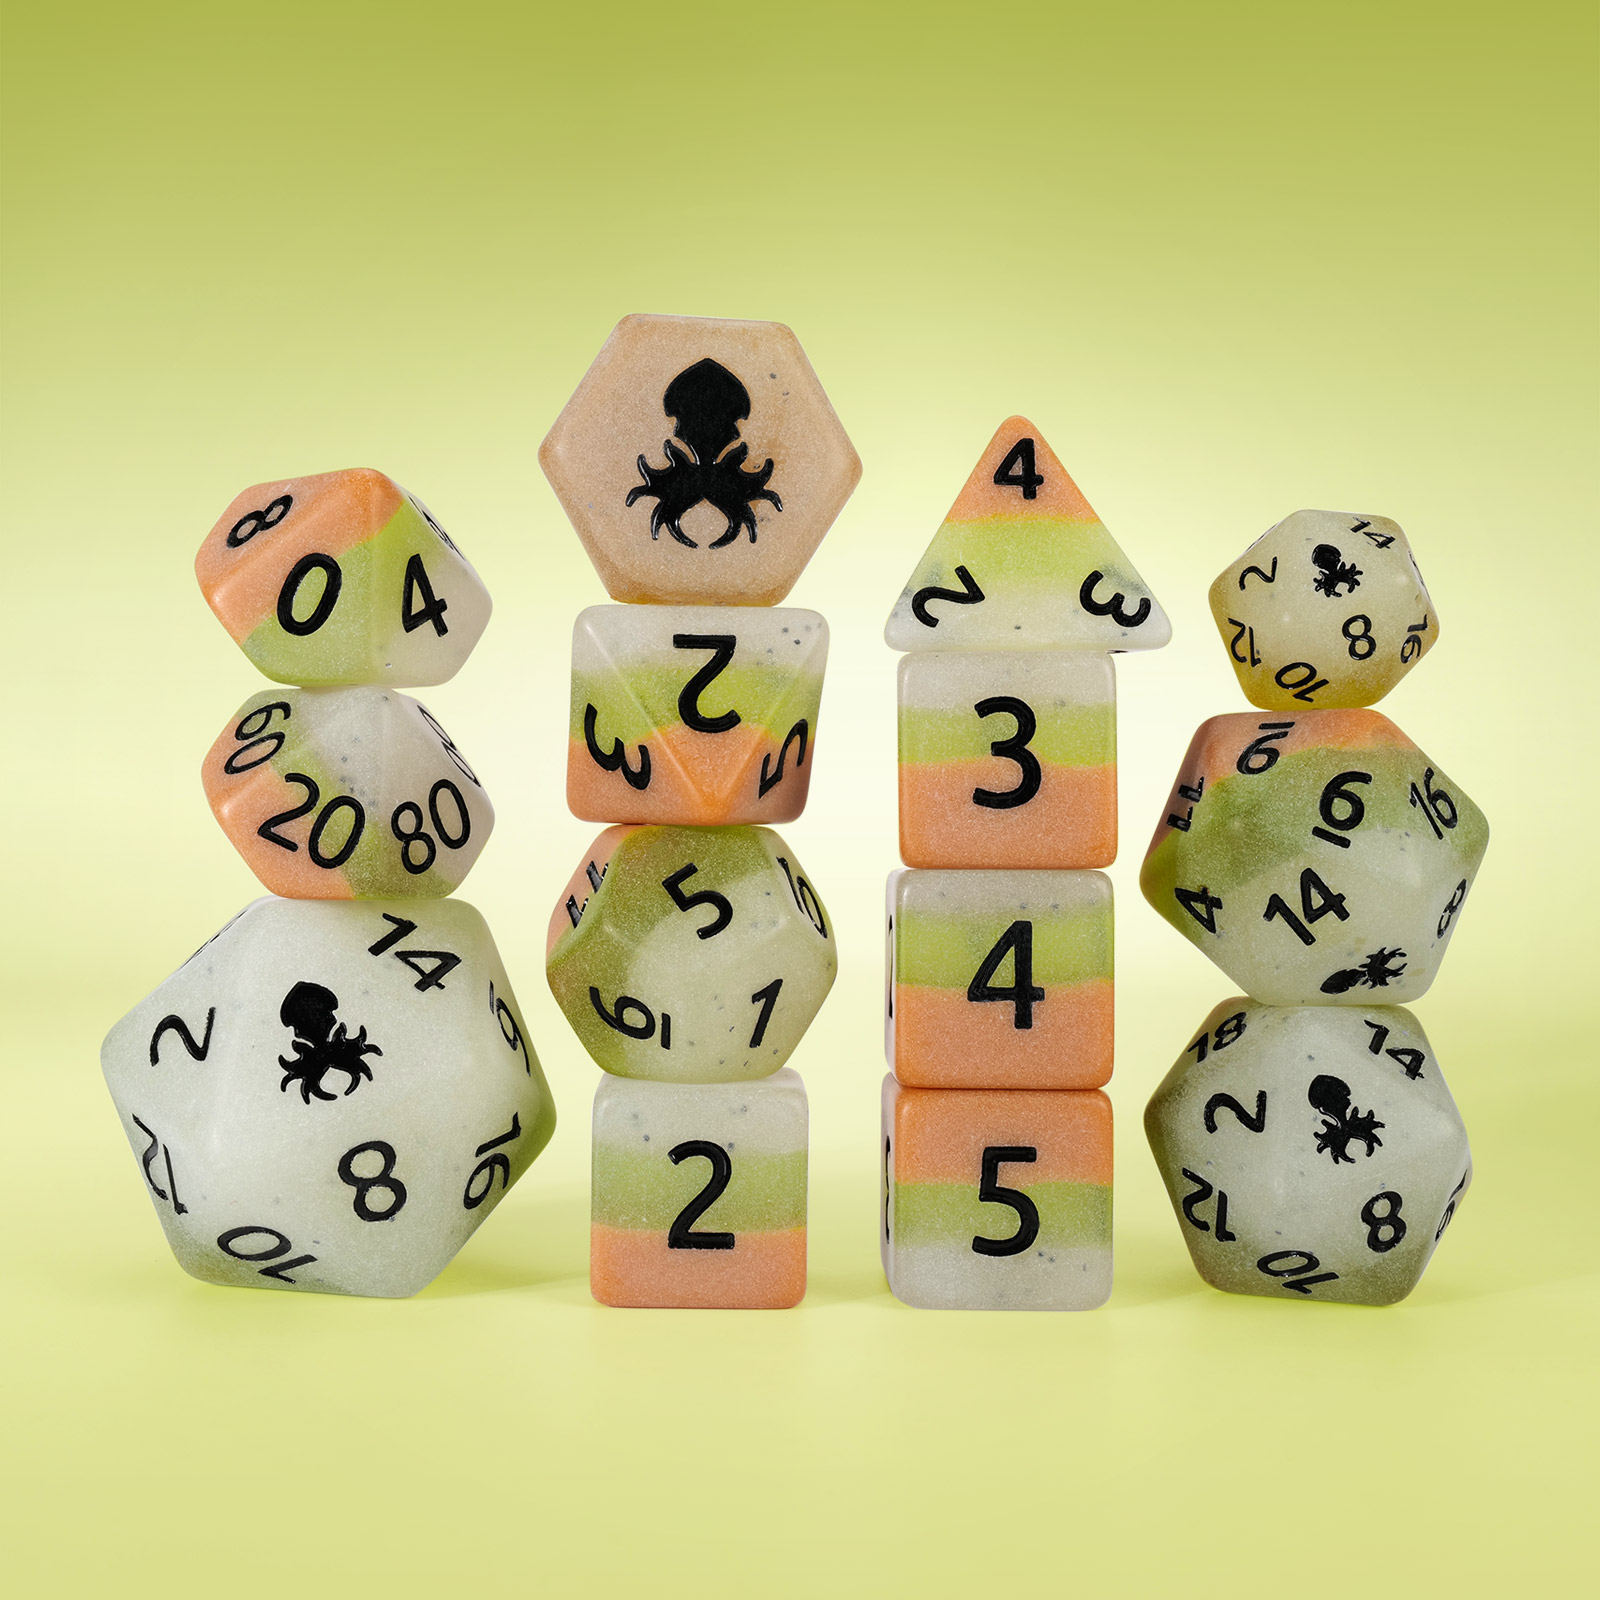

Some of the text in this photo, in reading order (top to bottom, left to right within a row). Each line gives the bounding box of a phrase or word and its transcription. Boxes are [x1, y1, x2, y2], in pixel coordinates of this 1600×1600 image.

[993, 437, 1045, 500] 4
[226, 494, 294, 549] 8
[1350, 516, 1396, 549] 14
[276, 552, 342, 637] 0
[401, 553, 449, 638] 4
[911, 564, 986, 628] 2
[1079, 569, 1152, 628] 3
[1238, 556, 1278, 591] 2
[1227, 617, 1262, 668] 12
[1341, 614, 1377, 661] 8
[1401, 614, 1428, 664] 16
[672, 633, 742, 734] 2
[1274, 661, 1330, 703] 10
[223, 701, 292, 775] 60
[583, 702, 652, 791] 3
[758, 718, 809, 800] 5
[972, 695, 1042, 810] 3
[257, 772, 366, 870] 20
[390, 778, 471, 875] 80
[1410, 767, 1458, 840] 16
[661, 862, 734, 940] 5
[776, 856, 828, 939] 10
[1174, 885, 1223, 935] 4
[1263, 867, 1350, 946] 14
[1437, 878, 1467, 940] 8
[367, 912, 463, 993] 14
[967, 920, 1045, 1030] 4
[149, 1006, 217, 1067] 2
[749, 978, 784, 1049] 1
[1187, 1011, 1247, 1064] 18
[1363, 1019, 1426, 1081] 14
[1203, 1089, 1267, 1134] 2
[132, 1113, 189, 1216] 12
[337, 1140, 408, 1223] 8
[463, 1111, 522, 1211] 16
[667, 1139, 736, 1250] 2
[971, 1145, 1040, 1257] 5
[1181, 1167, 1237, 1243] 12
[1360, 1190, 1407, 1254] 8
[216, 1225, 319, 1285] 10
[1256, 1250, 1340, 1295] 10
